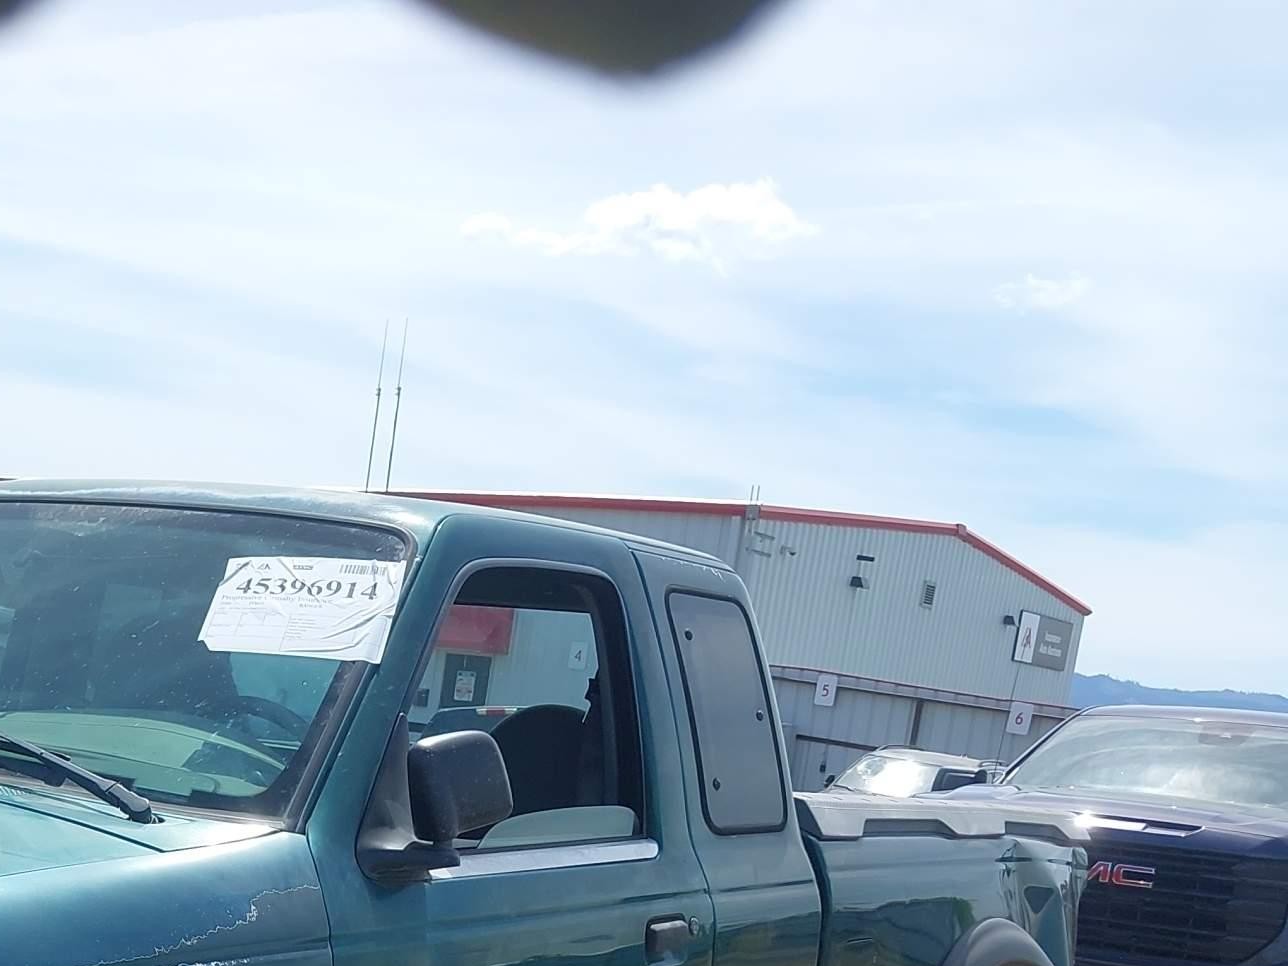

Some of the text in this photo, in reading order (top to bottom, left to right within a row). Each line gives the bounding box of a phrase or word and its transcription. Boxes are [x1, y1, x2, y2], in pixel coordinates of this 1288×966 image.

[235, 577, 378, 601] 45396914
[574, 649, 582, 661] 4
[822, 684, 830, 697] 5
[1015, 712, 1024, 725] 6
